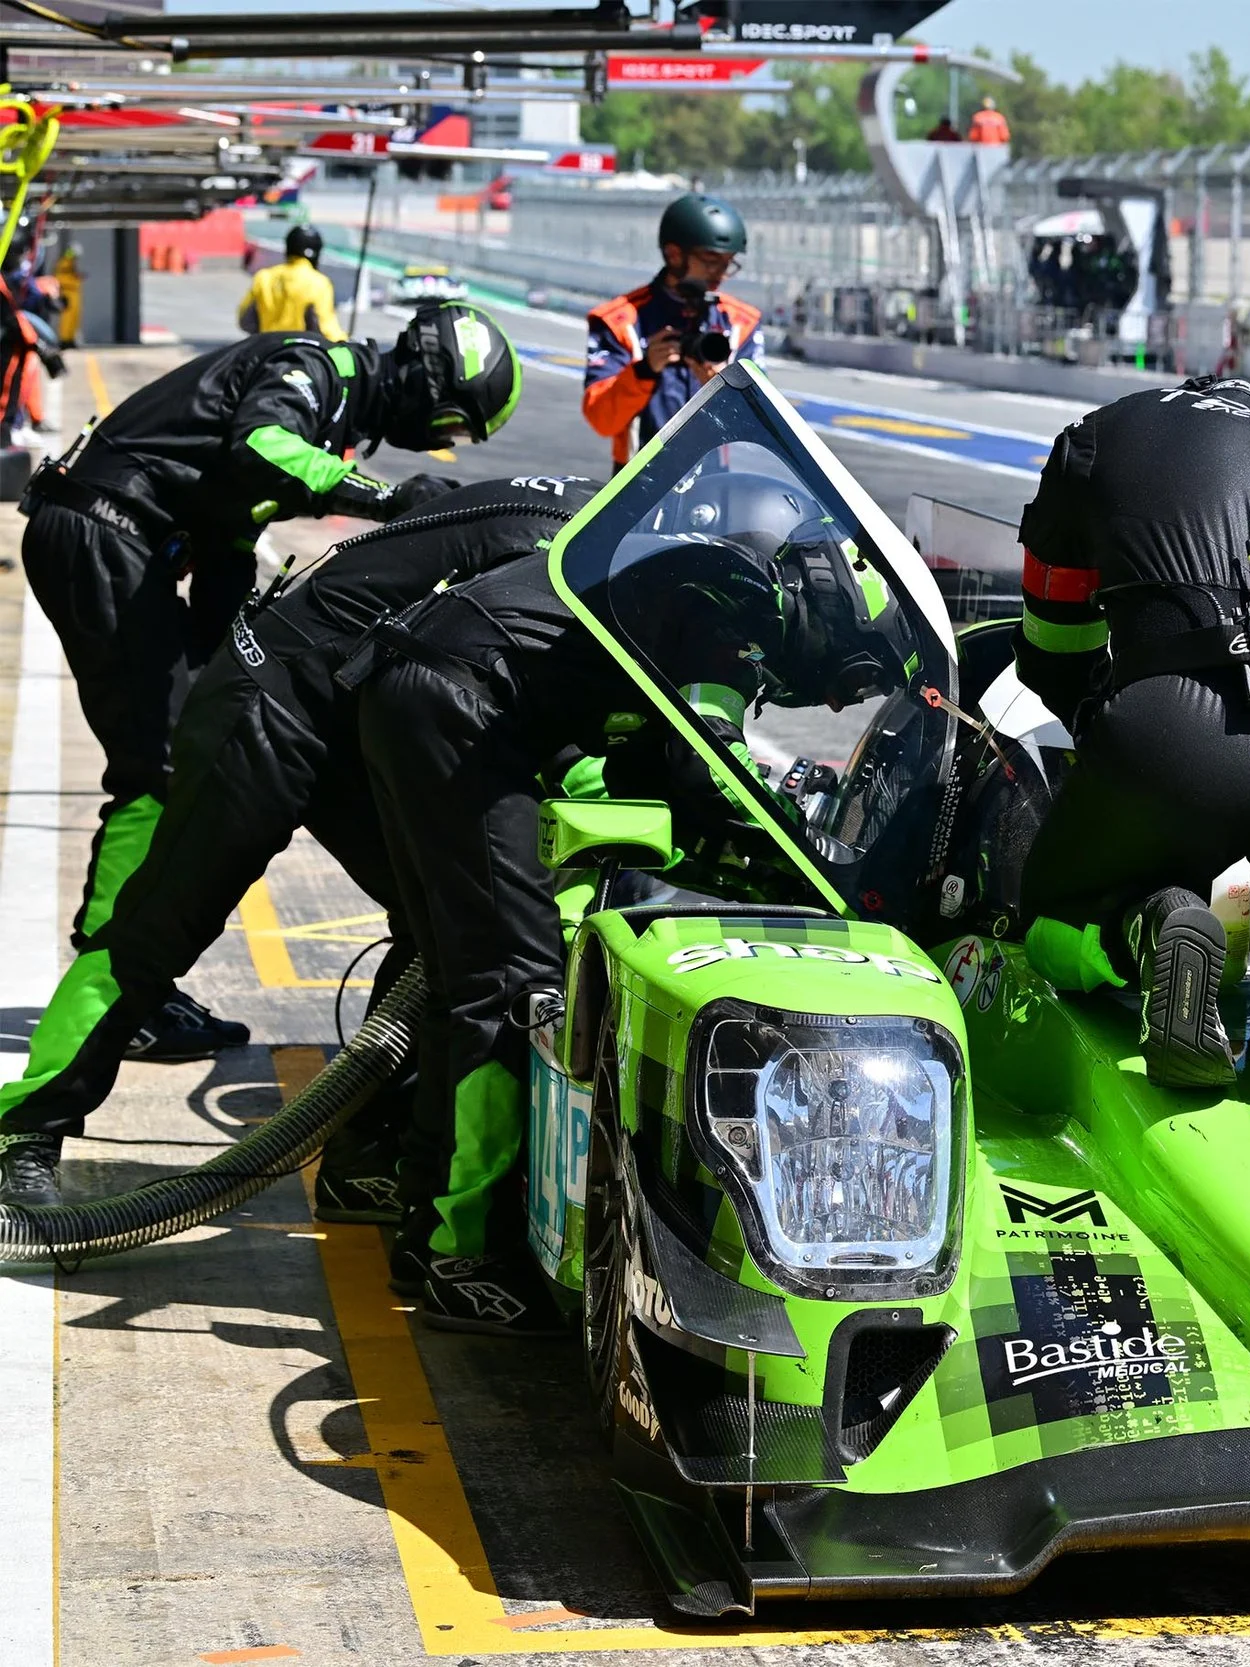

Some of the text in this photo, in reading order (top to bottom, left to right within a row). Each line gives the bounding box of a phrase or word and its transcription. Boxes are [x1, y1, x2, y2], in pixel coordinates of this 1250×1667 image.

[741, 23, 858, 41] IDEC.SPORT
[669, 938, 942, 985] shop
[532, 1066, 560, 1227] 14
[996, 1229, 1131, 1242] PATRIMOINE
[624, 1258, 684, 1331] MOTU
[1004, 1320, 1187, 1375] Bastide
[1098, 1360, 1192, 1379] MEDICAL
